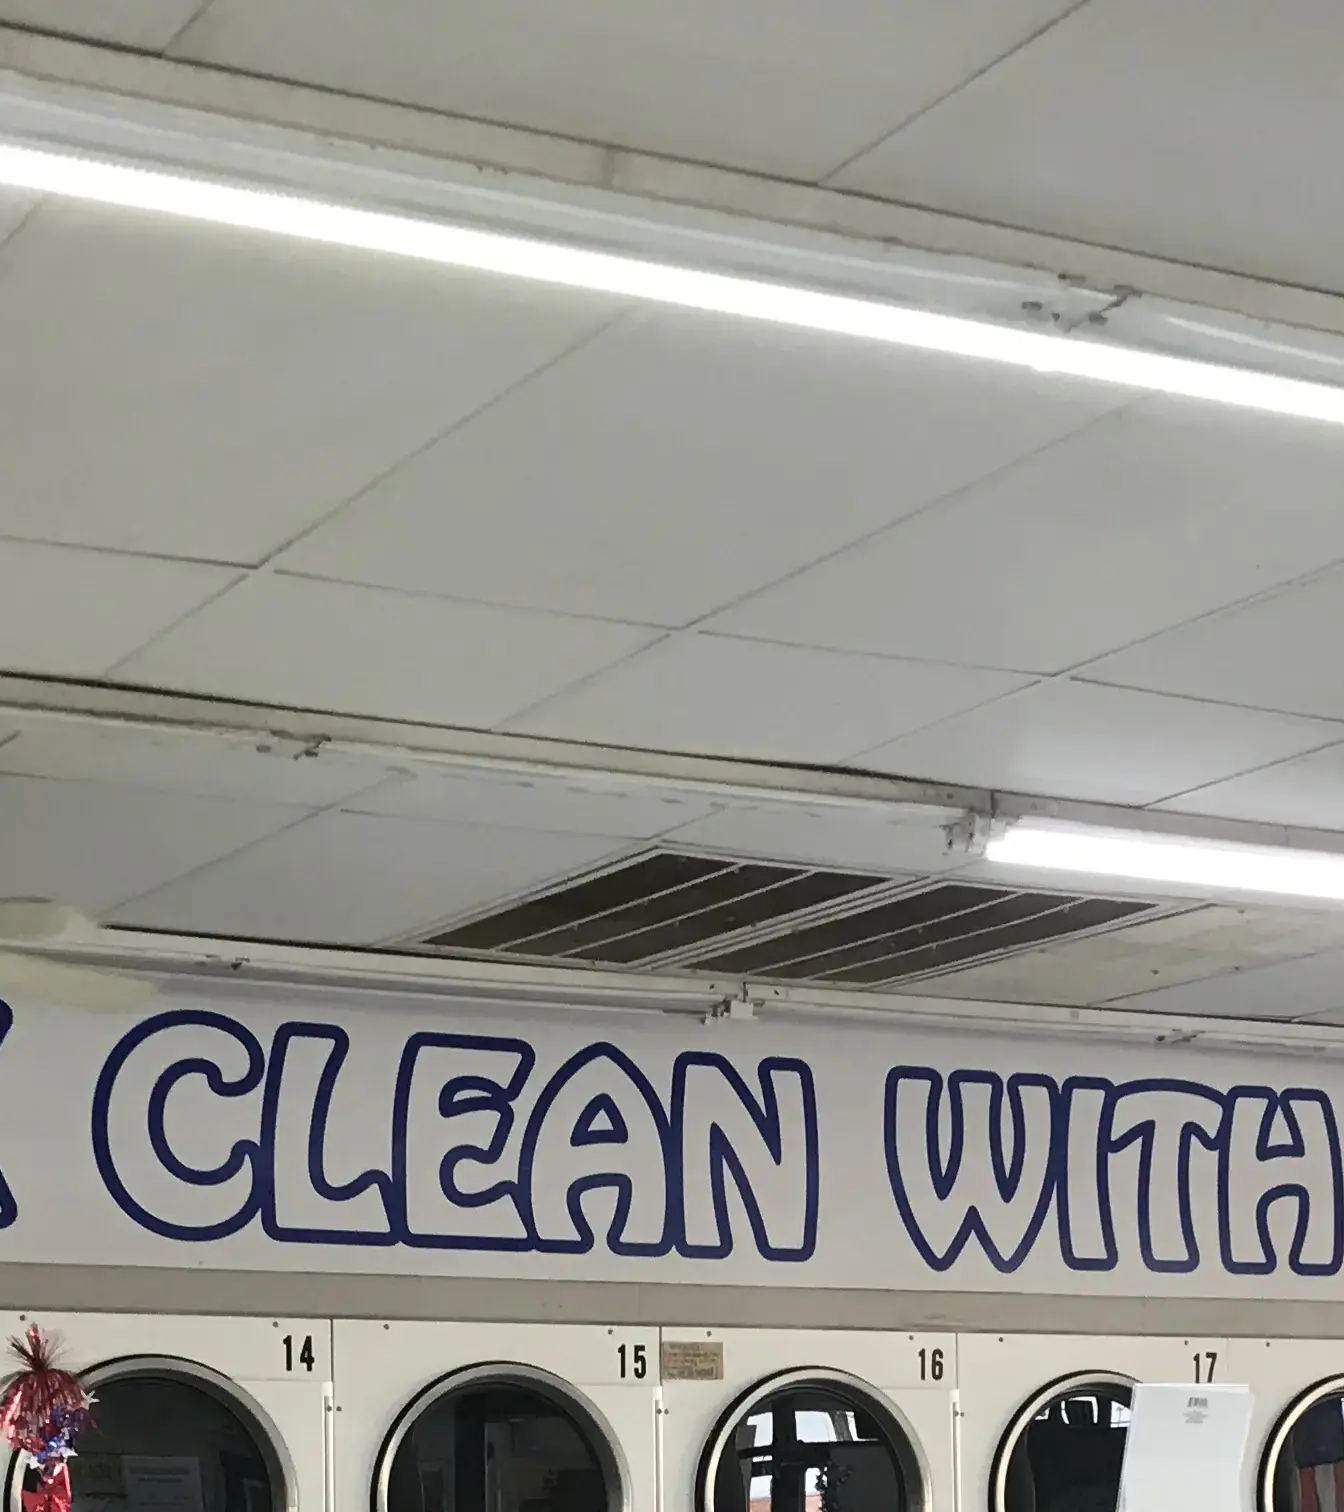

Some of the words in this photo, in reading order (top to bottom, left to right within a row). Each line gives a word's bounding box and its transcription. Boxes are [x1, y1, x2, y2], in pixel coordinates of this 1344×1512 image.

[92, 1010, 819, 1262] CLEAN
[884, 1065, 1344, 1277] WITH
[282, 1334, 315, 1372] 14
[617, 1344, 647, 1379] 15
[918, 1348, 944, 1381] 16
[1193, 1352, 1217, 1384] 17
